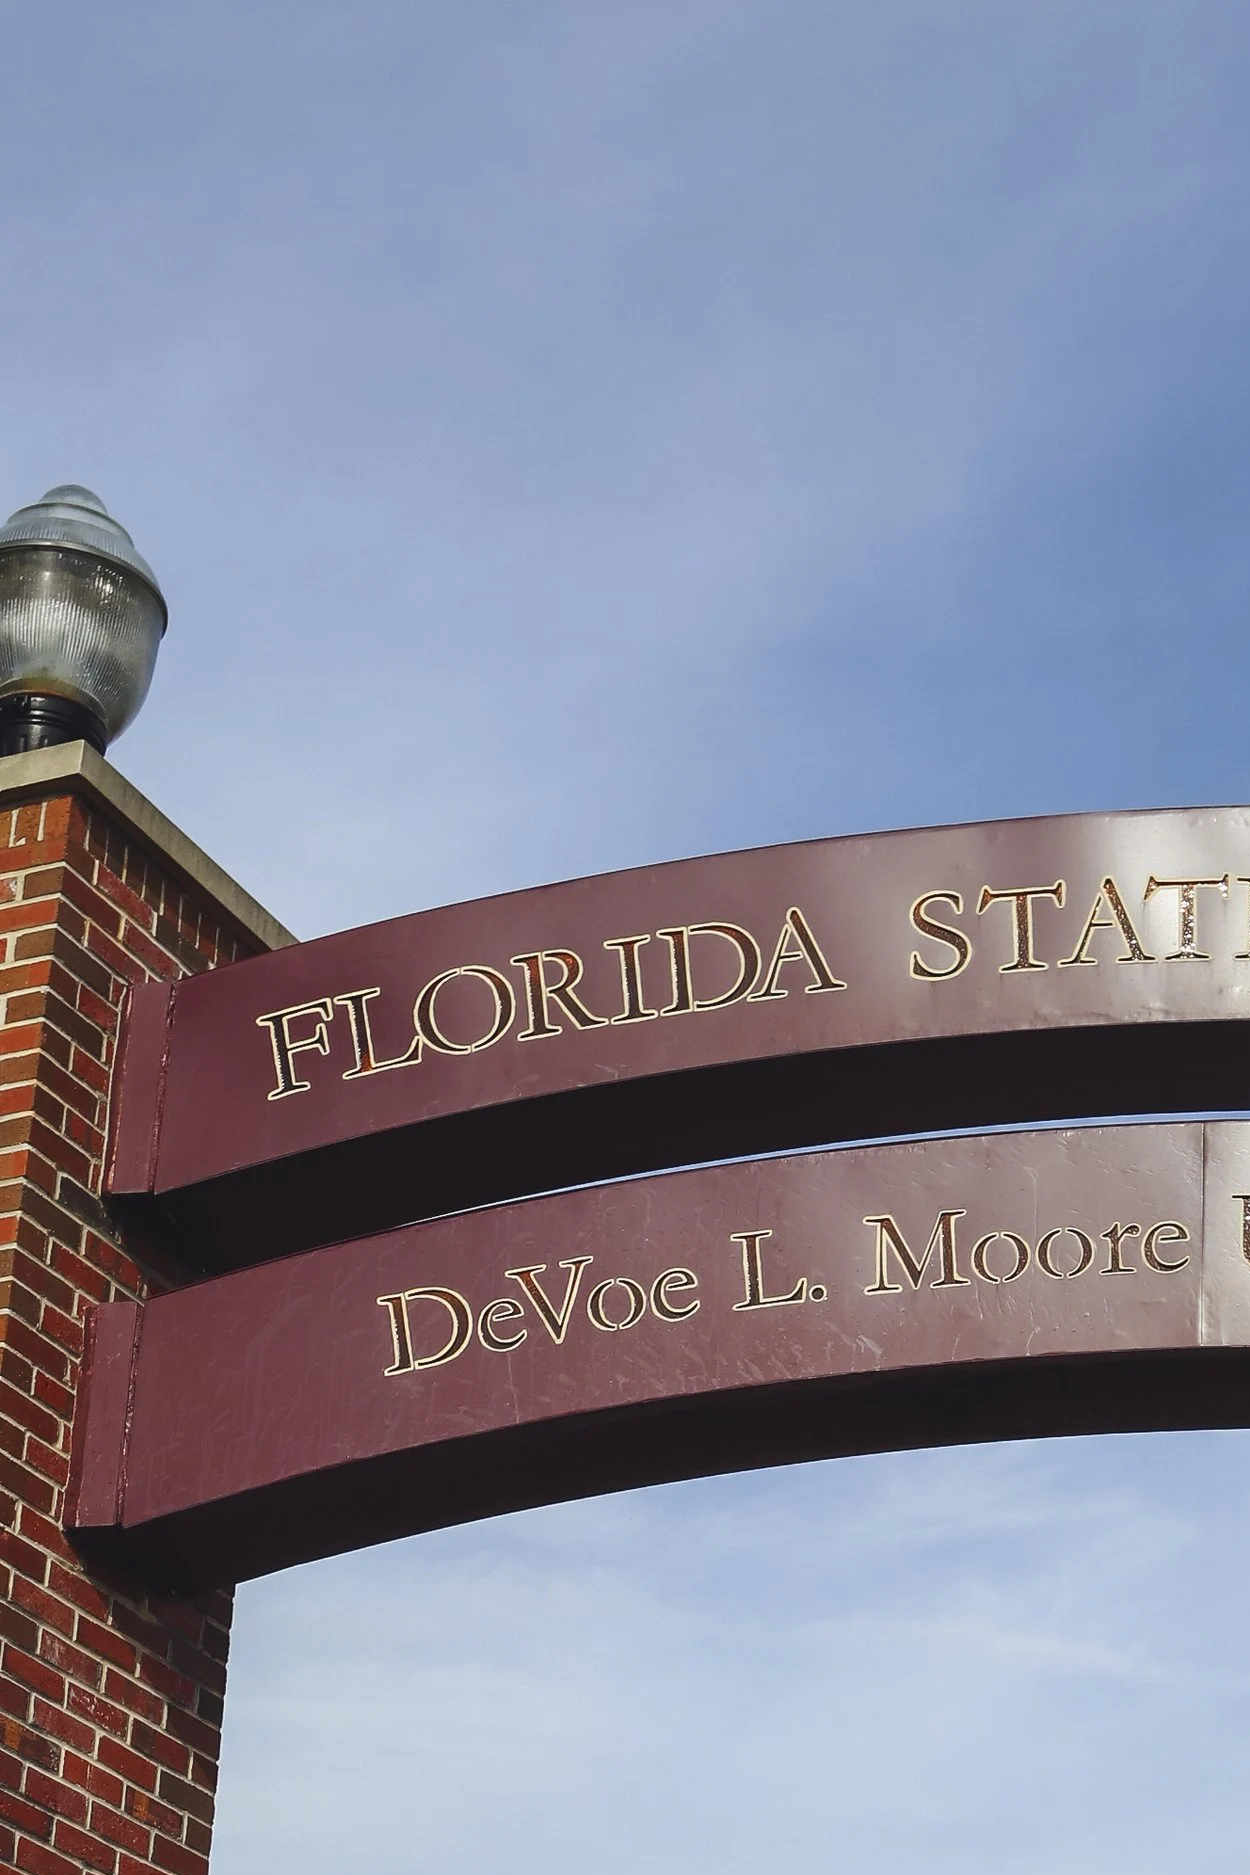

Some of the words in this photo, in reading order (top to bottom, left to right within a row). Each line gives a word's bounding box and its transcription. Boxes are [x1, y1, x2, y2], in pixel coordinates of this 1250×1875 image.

[256, 906, 848, 1101] FLORIDA
[375, 1255, 701, 1377] DeVoe
[730, 1229, 829, 1312] L.
[862, 1207, 1192, 1296] Moore
